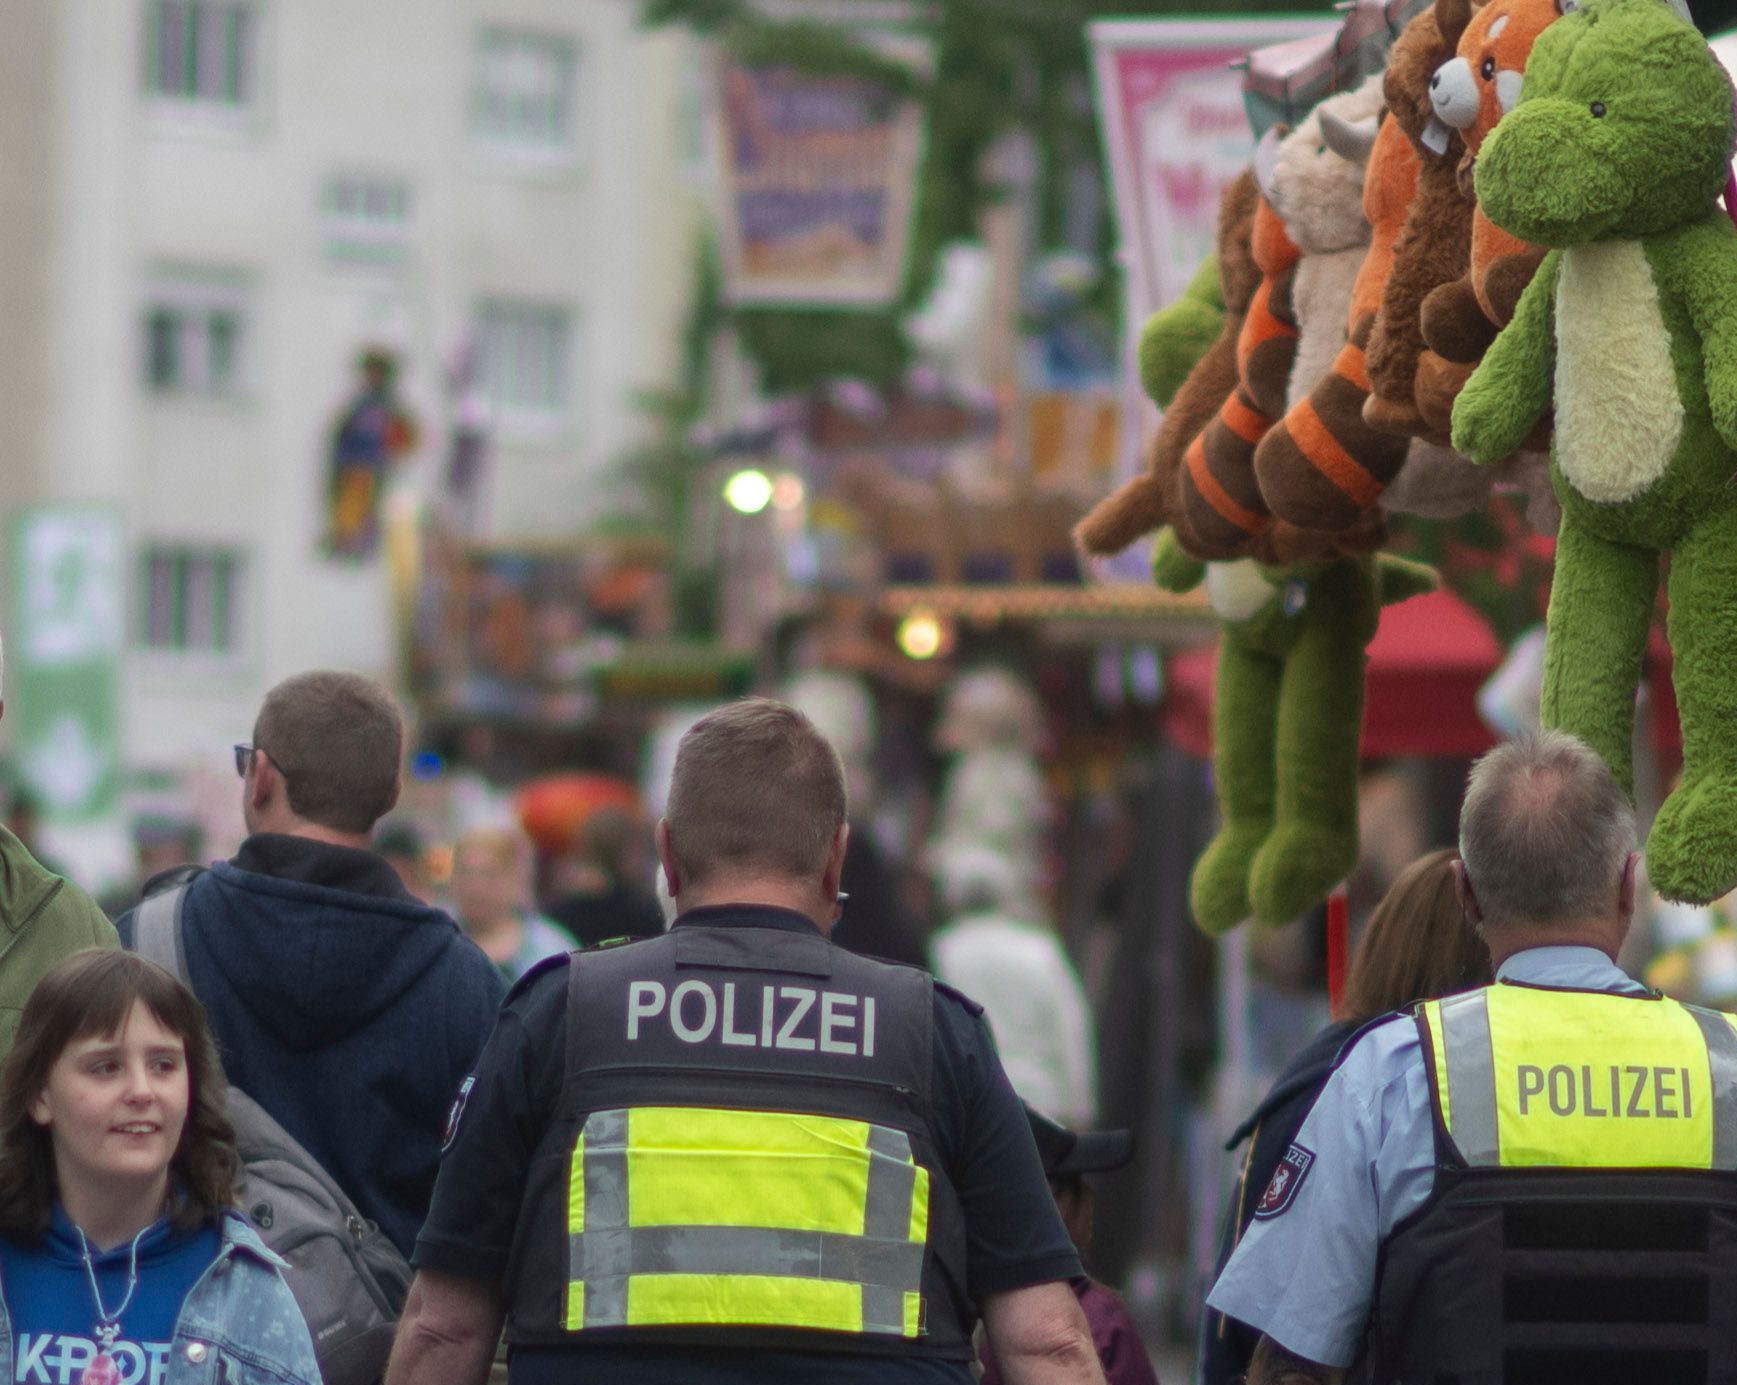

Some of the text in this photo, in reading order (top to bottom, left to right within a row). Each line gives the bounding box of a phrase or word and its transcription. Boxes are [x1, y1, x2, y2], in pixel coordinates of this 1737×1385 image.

[627, 979, 875, 1057] POLIZEI
[1517, 1064, 1692, 1118] POLIZEI
[1283, 1149, 1308, 1170] IZEI
